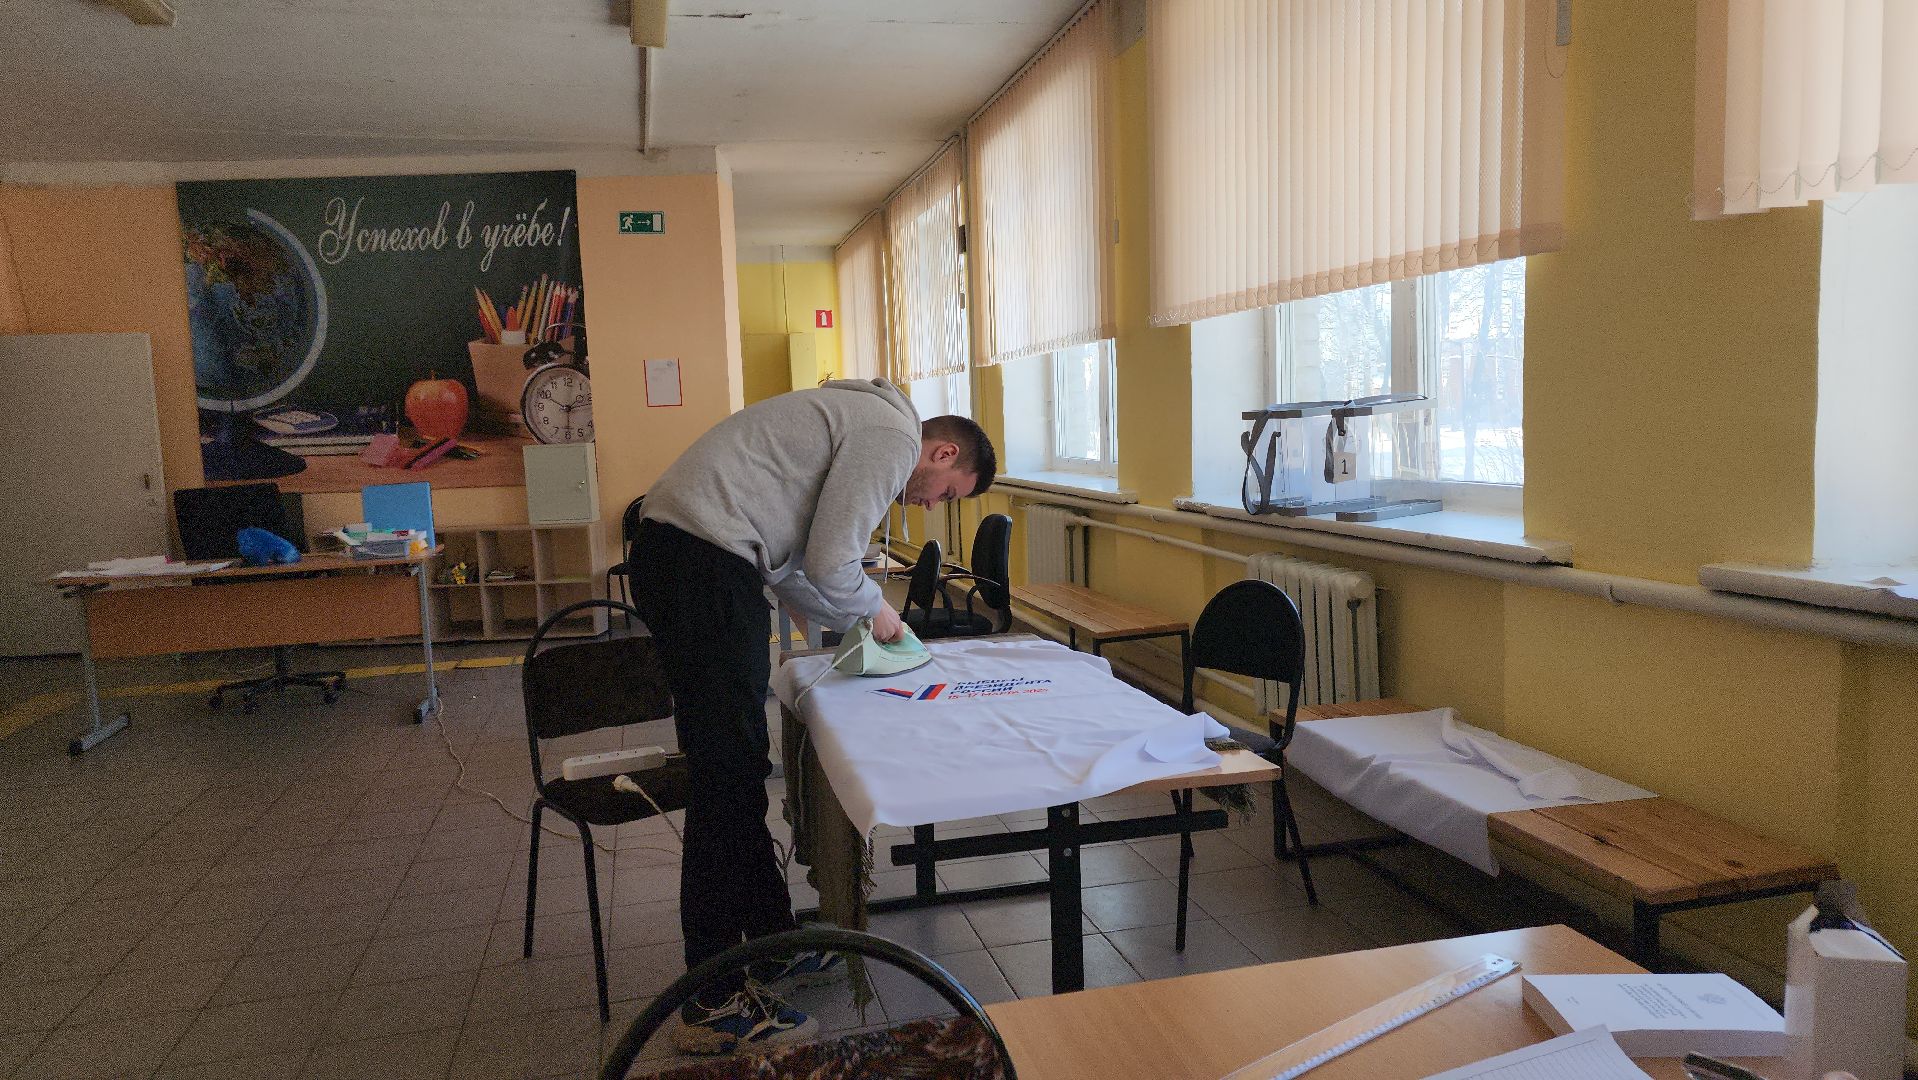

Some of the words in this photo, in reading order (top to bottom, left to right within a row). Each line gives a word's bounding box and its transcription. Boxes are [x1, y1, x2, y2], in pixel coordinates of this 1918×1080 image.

[319, 197, 450, 264] Успехов
[456, 200, 474, 249] в
[481, 198, 570, 272] учёбе!
[820, 311, 828, 327] 1
[563, 378, 573, 387] 12
[1341, 458, 1349, 475] 1
